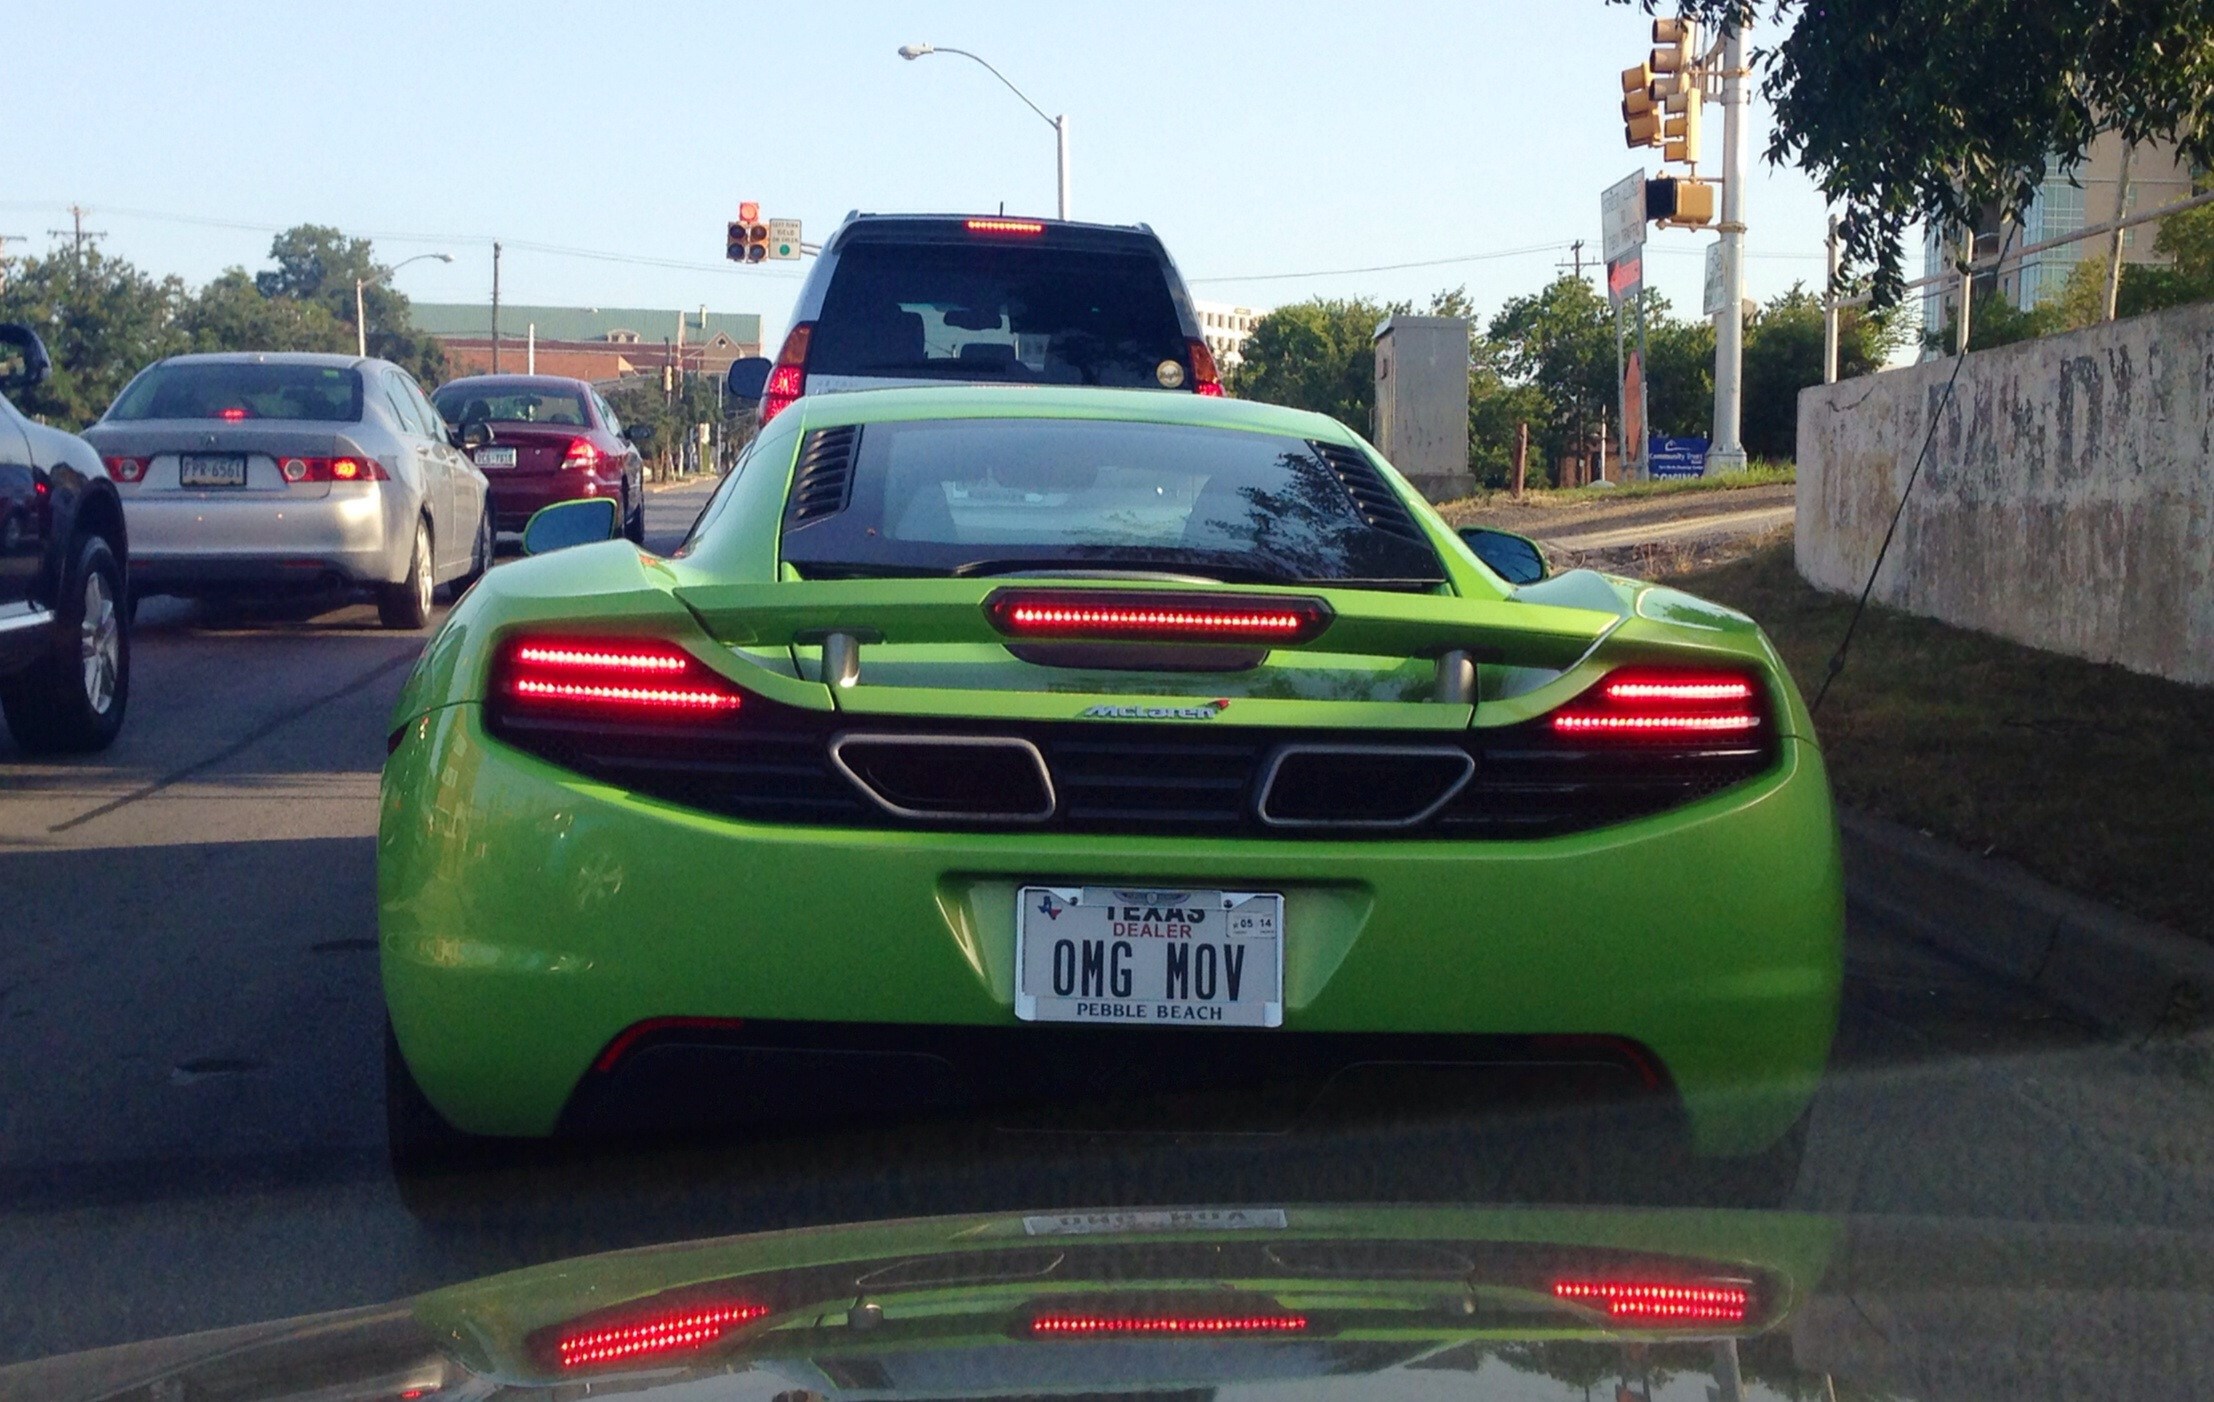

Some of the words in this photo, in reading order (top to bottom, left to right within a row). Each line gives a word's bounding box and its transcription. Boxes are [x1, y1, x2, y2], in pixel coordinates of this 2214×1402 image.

[1085, 704, 1215, 718] McLaren
[1107, 906, 1205, 924] TEXAS
[1113, 923, 1192, 938] DEALER
[1240, 919, 1254, 928] 05
[1260, 919, 1272, 928] 14
[1053, 939, 1132, 998] OMG
[1166, 942, 1245, 1001] MOV
[1076, 1003, 1147, 1018] PEBBLE
[1157, 1005, 1222, 1020] BEACH
